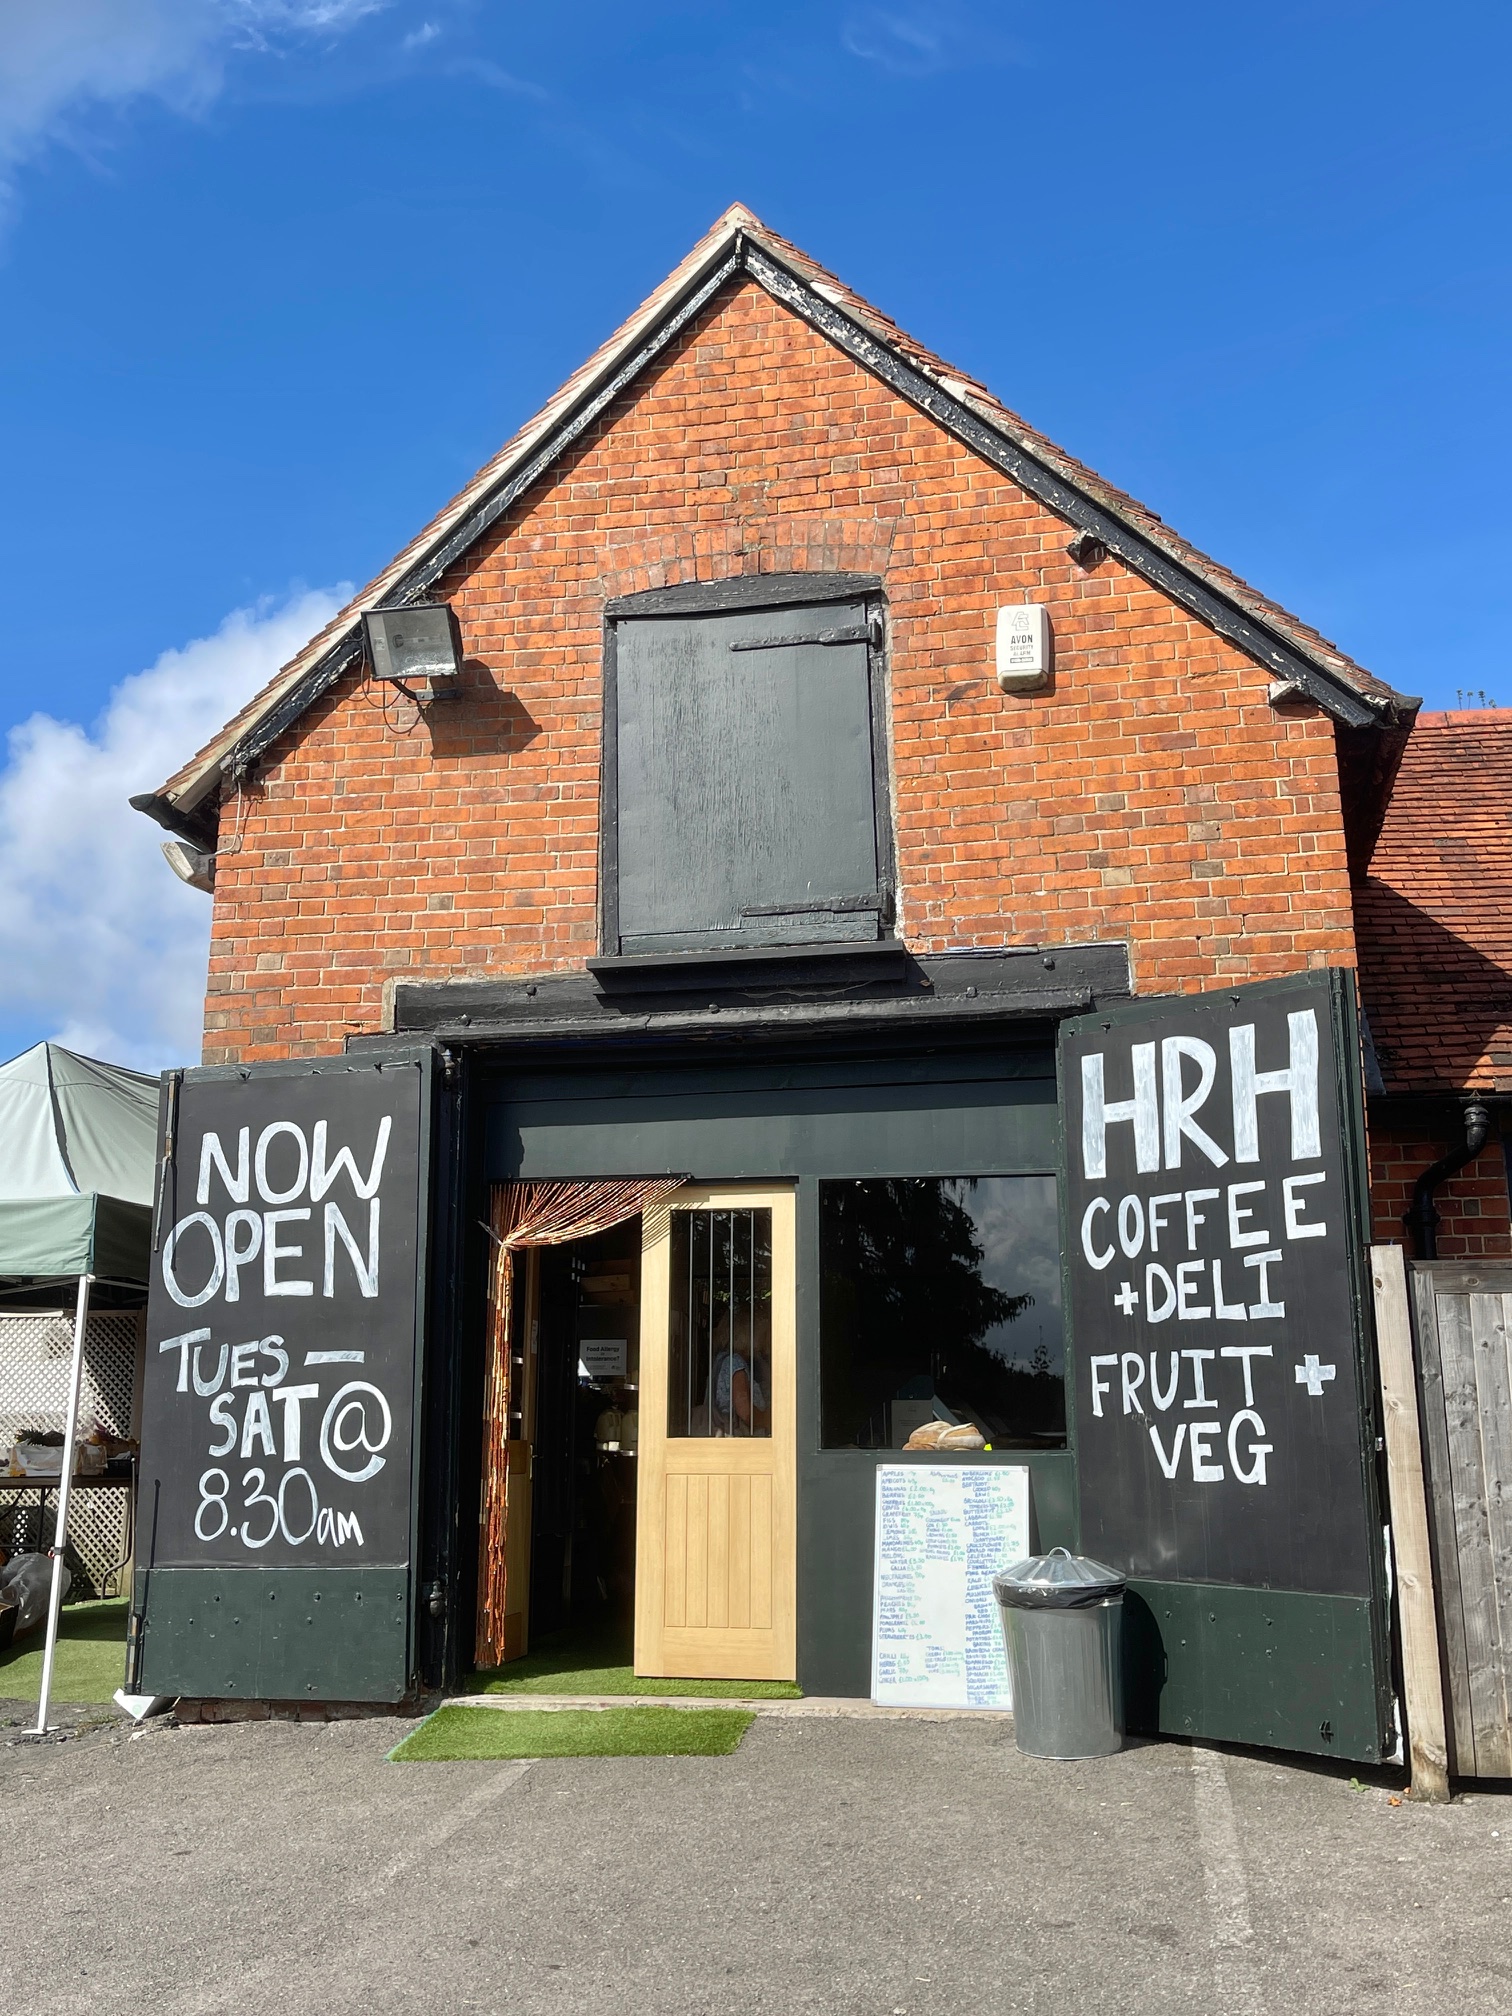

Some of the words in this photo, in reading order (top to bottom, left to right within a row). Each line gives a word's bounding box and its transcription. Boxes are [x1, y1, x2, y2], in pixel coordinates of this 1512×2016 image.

[1010, 634, 1033, 645] AVON
[1081, 1008, 1322, 1180] HRH
[196, 1115, 393, 1205] NOW
[162, 1197, 381, 1308] OPEN
[1081, 1171, 1327, 1270] COFFEE
[158, 1327, 291, 1397] TUES
[1090, 1345, 1273, 1417] FRUIT
[208, 1383, 319, 1462] SAT
[320, 1380, 393, 1483] @
[1149, 1409, 1274, 1486] VEG
